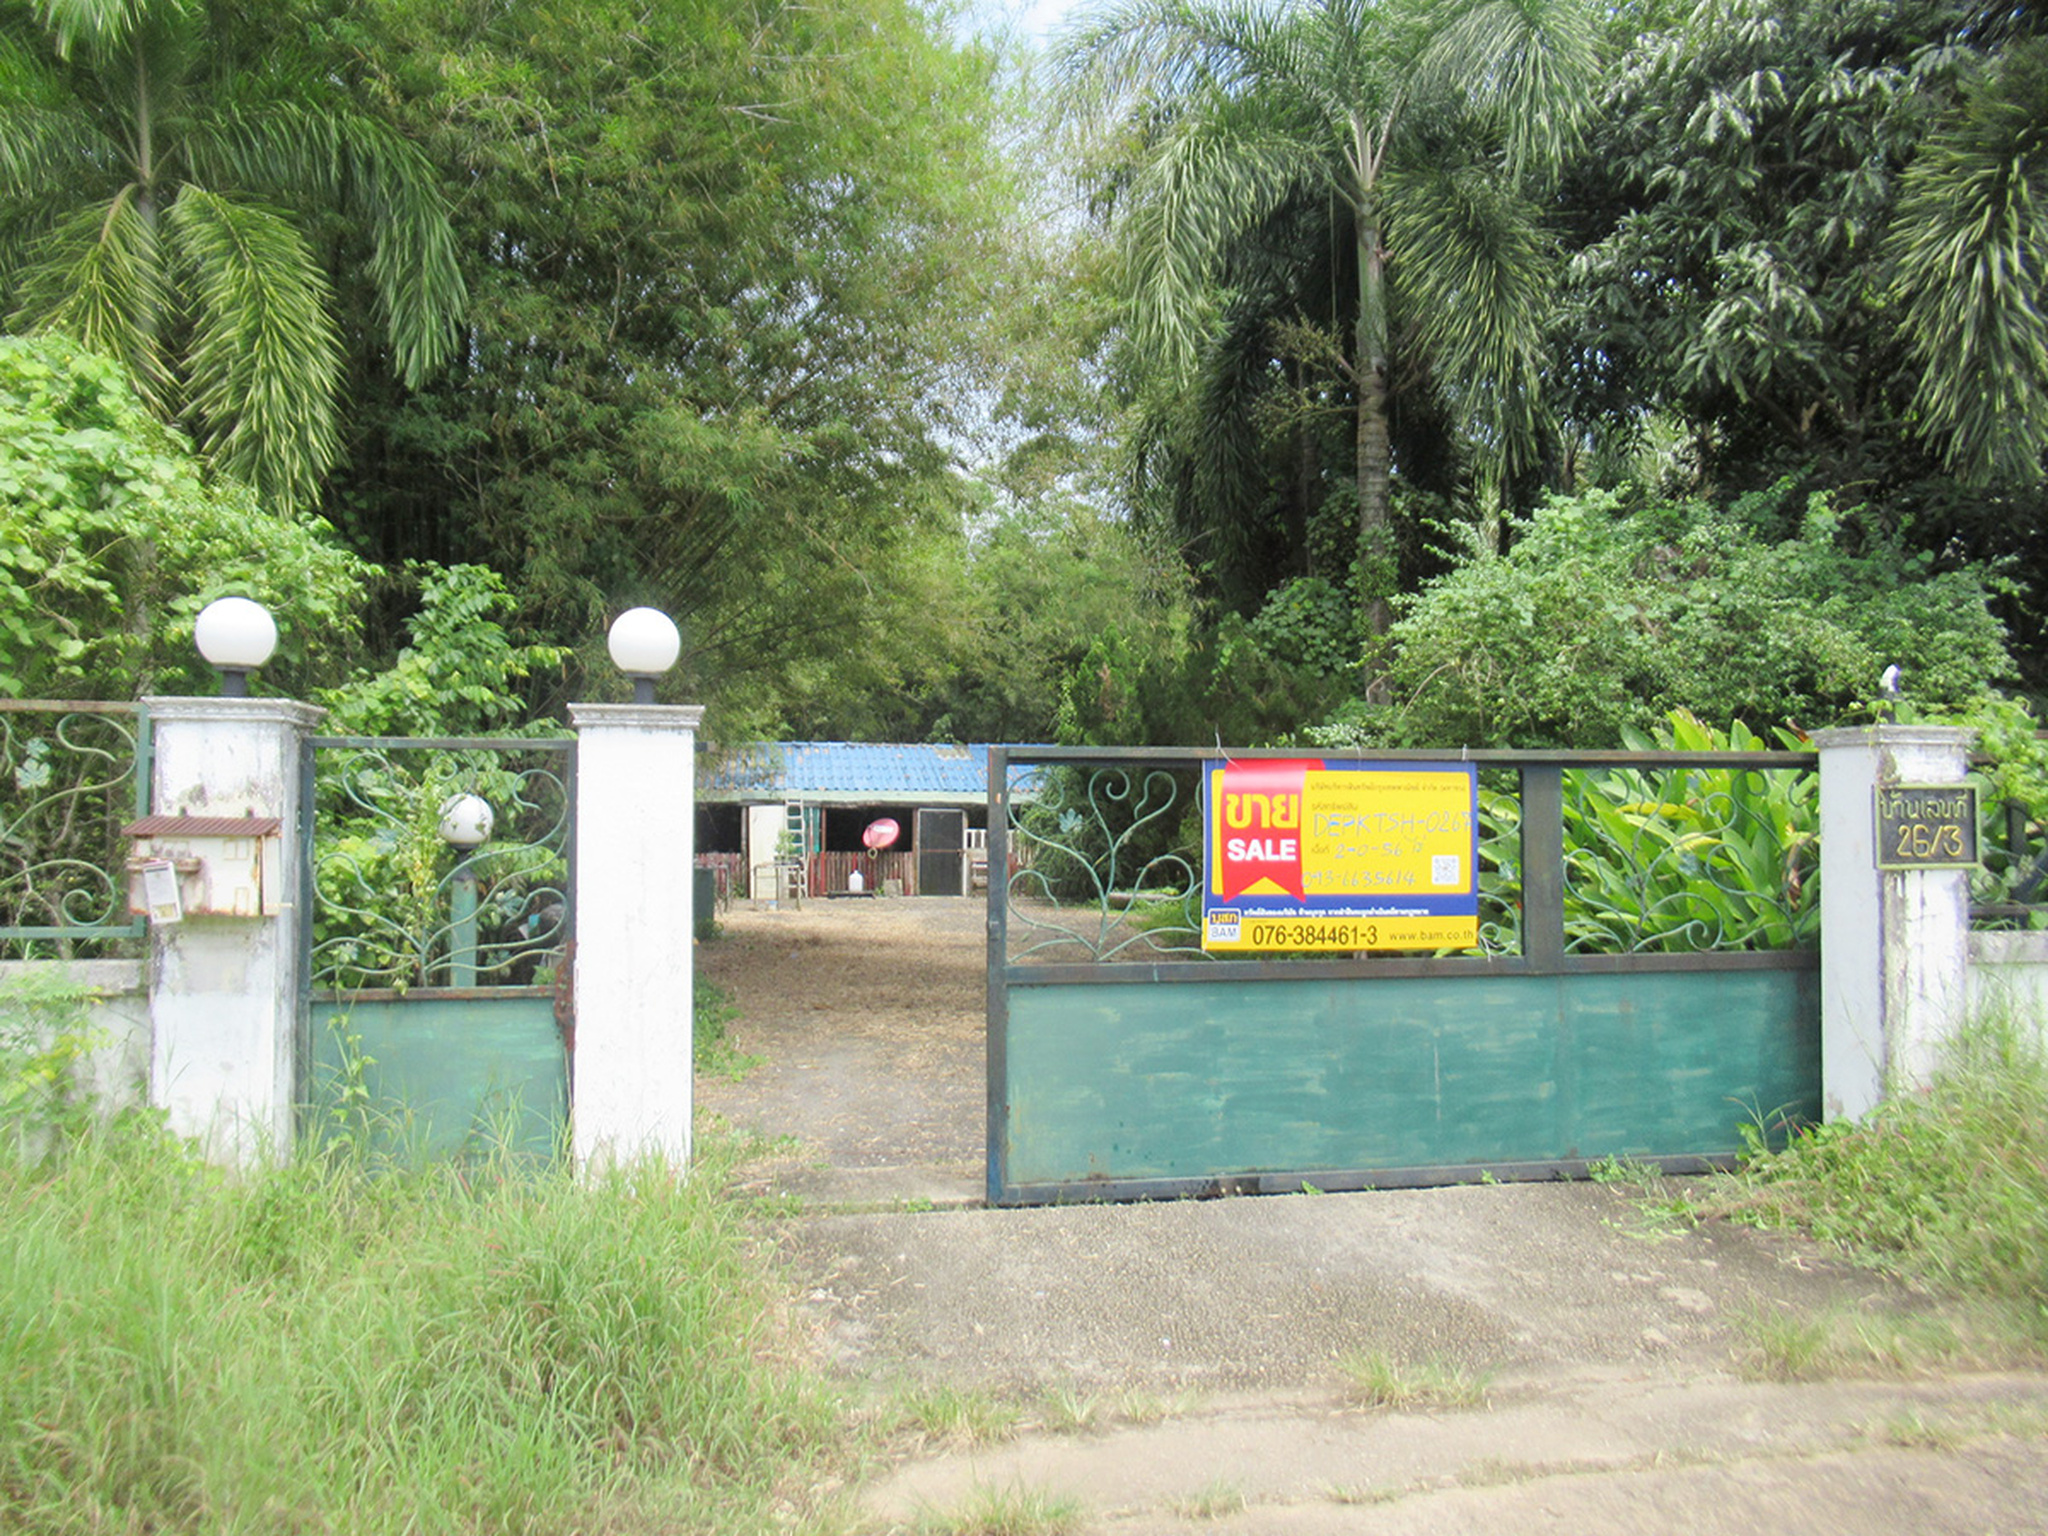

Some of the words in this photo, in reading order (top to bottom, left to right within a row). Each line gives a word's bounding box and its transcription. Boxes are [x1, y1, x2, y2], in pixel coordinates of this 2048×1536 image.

[1226, 793, 1298, 829] ขาย
[1227, 839, 1297, 862] SALE
[1896, 824, 1963, 858] 26/3
[1211, 927, 1237, 938] BAM
[1252, 925, 1378, 945] 076-384461-3
[1389, 928, 1474, 941] www.bam.co.th
